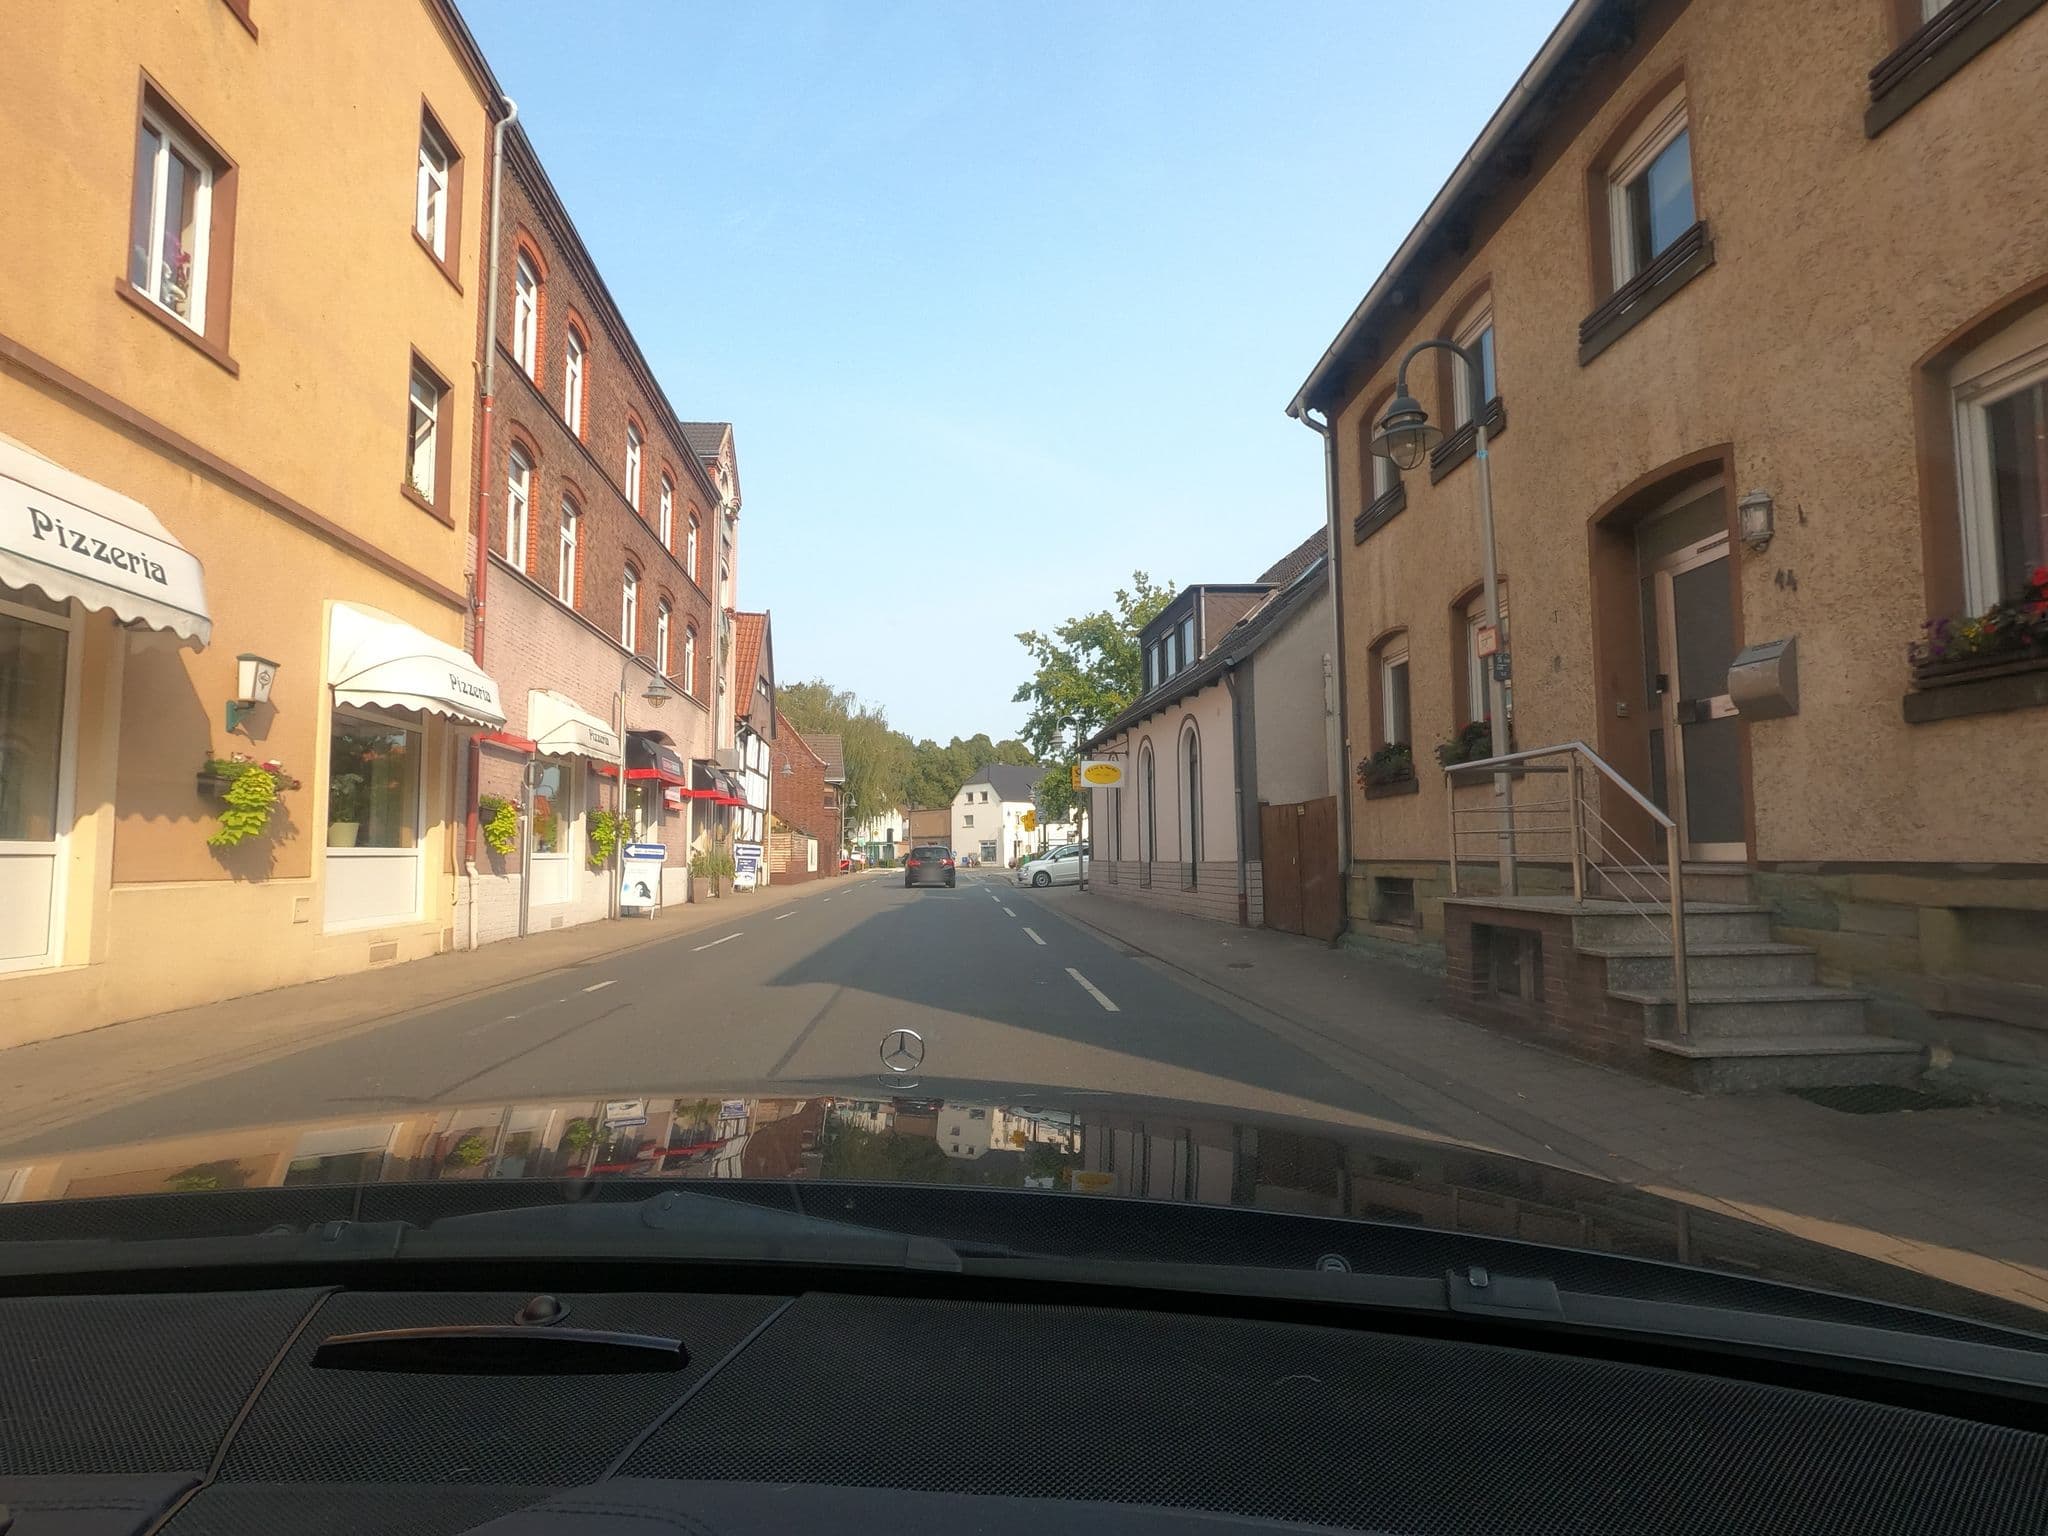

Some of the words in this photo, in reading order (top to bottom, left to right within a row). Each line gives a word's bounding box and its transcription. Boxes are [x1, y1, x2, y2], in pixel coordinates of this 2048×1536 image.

[27, 506, 168, 586] Pizzeria
[1775, 568, 1798, 592] 44
[449, 673, 493, 704] Pizzeria
[588, 728, 610, 747] Pizzeria
